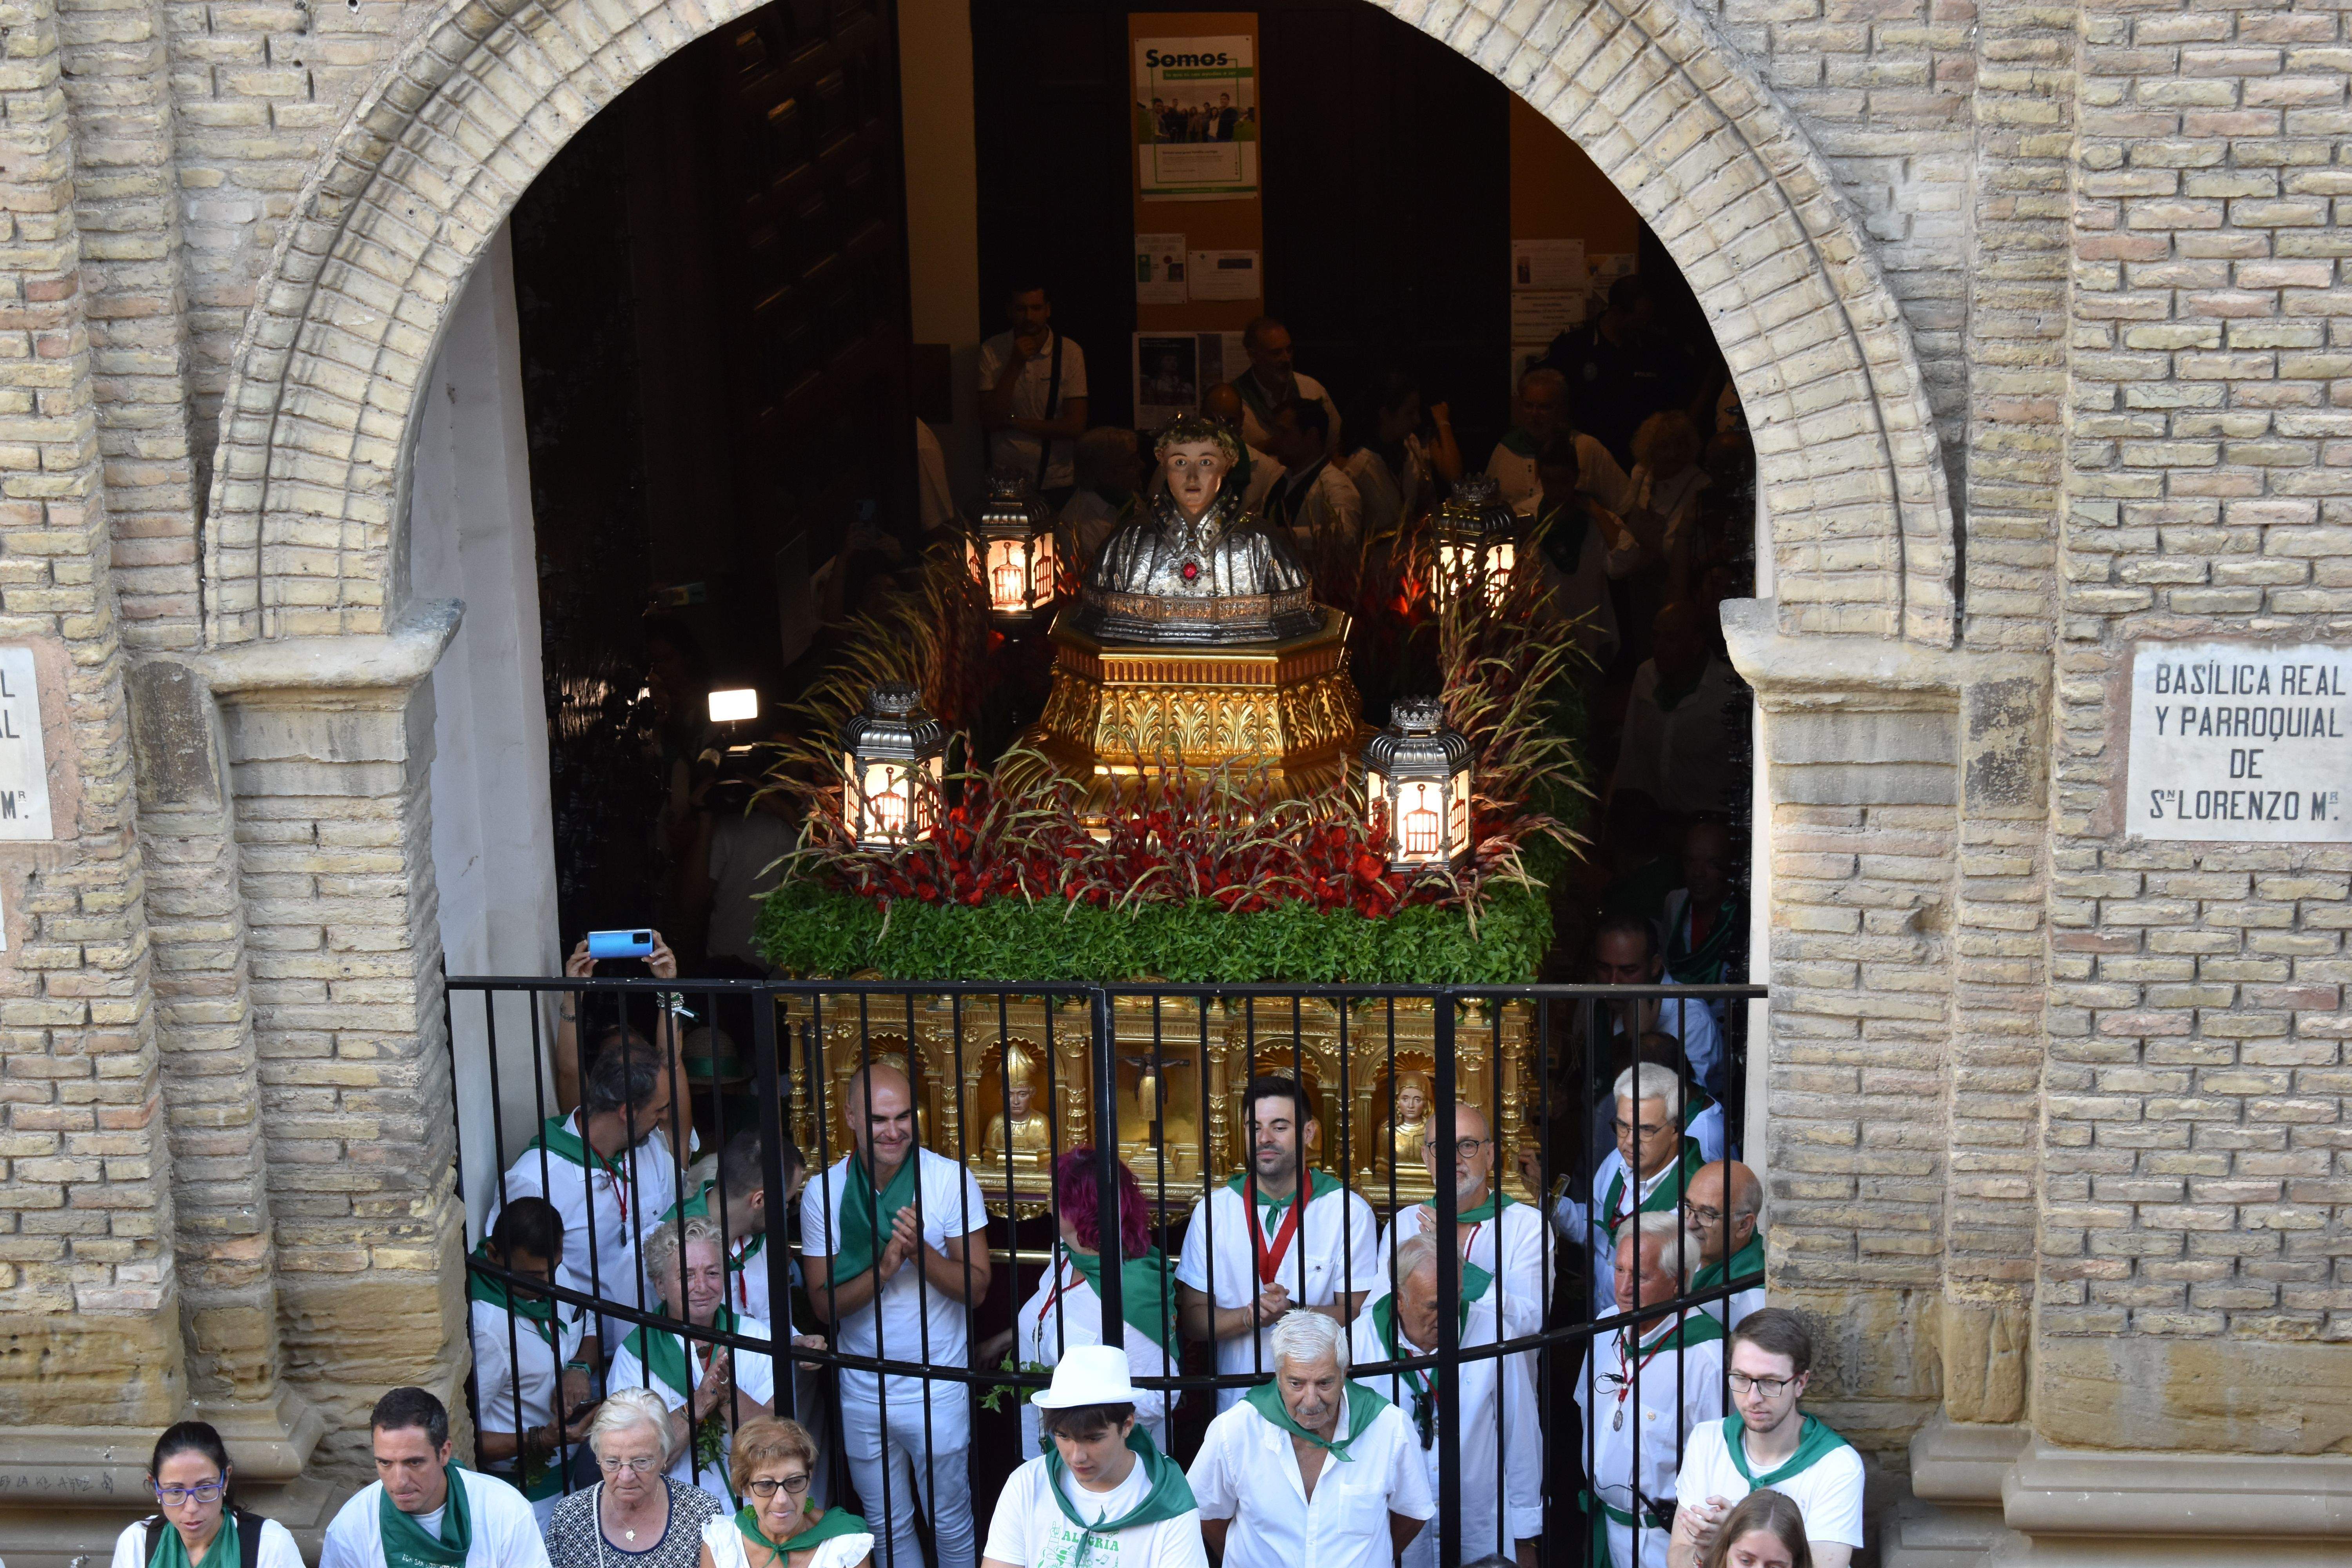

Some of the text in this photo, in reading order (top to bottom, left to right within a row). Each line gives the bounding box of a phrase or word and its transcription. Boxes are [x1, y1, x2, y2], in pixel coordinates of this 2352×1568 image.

[1146, 49, 1227, 67] Somos
[2155, 659, 2347, 696] BASÍLICA REAL
[2155, 706, 2343, 742] Y PARROQUIAL
[2229, 748, 2264, 779] DE
[1061, 1530, 1119, 1552] ALGRIA
